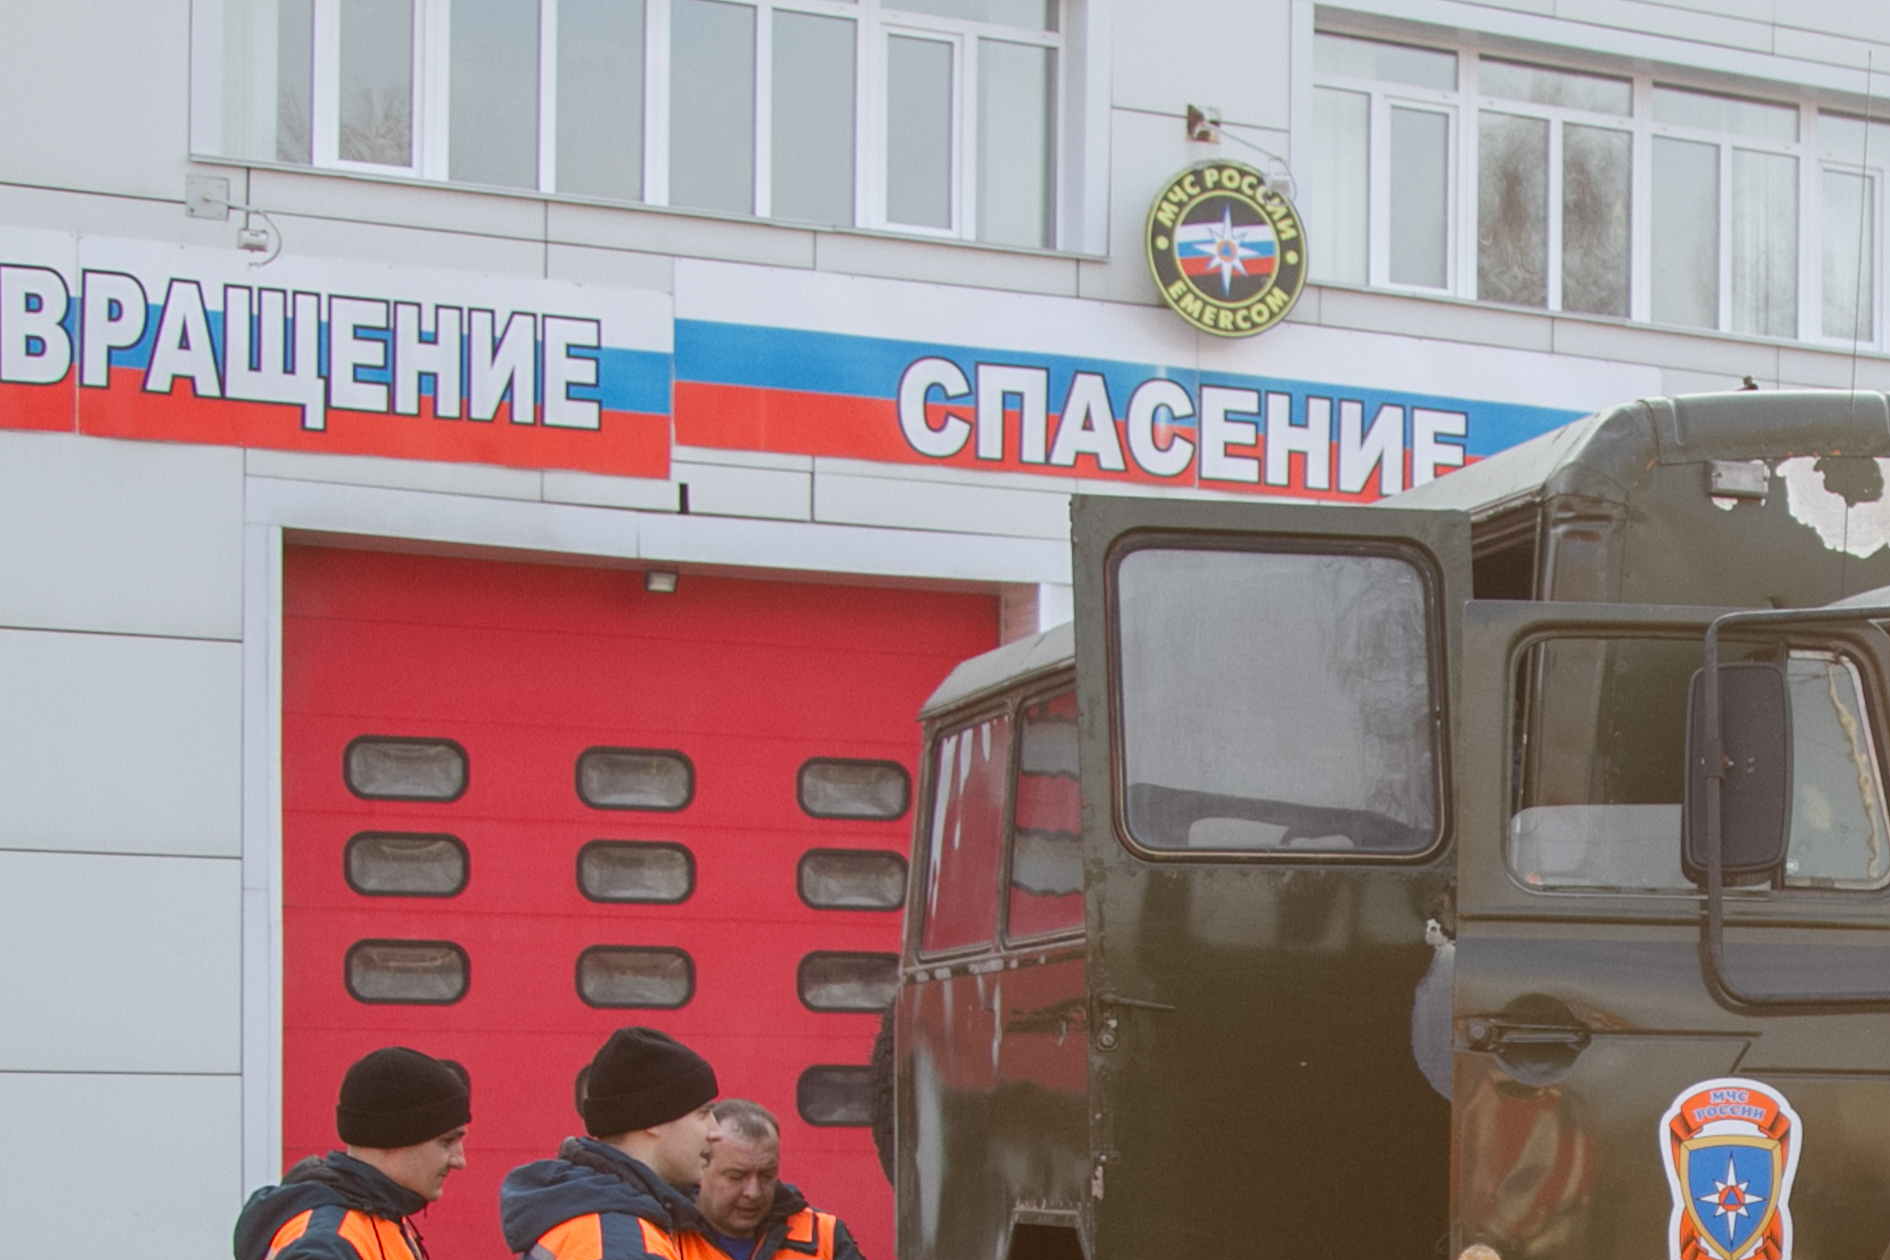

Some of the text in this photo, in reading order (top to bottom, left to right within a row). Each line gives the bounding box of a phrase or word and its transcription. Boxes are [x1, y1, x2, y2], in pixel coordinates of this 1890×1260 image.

[1156, 167, 1298, 240] МЧС РОССИИ
[1167, 279, 1290, 330] EMERCOM
[0, 263, 601, 432] ВРАЩЕНИЕ
[897, 356, 1469, 497] СПАСЕНИЕ
[1695, 1104, 1765, 1120] РОССИИ
[1711, 1090, 1749, 1102] МЧС
